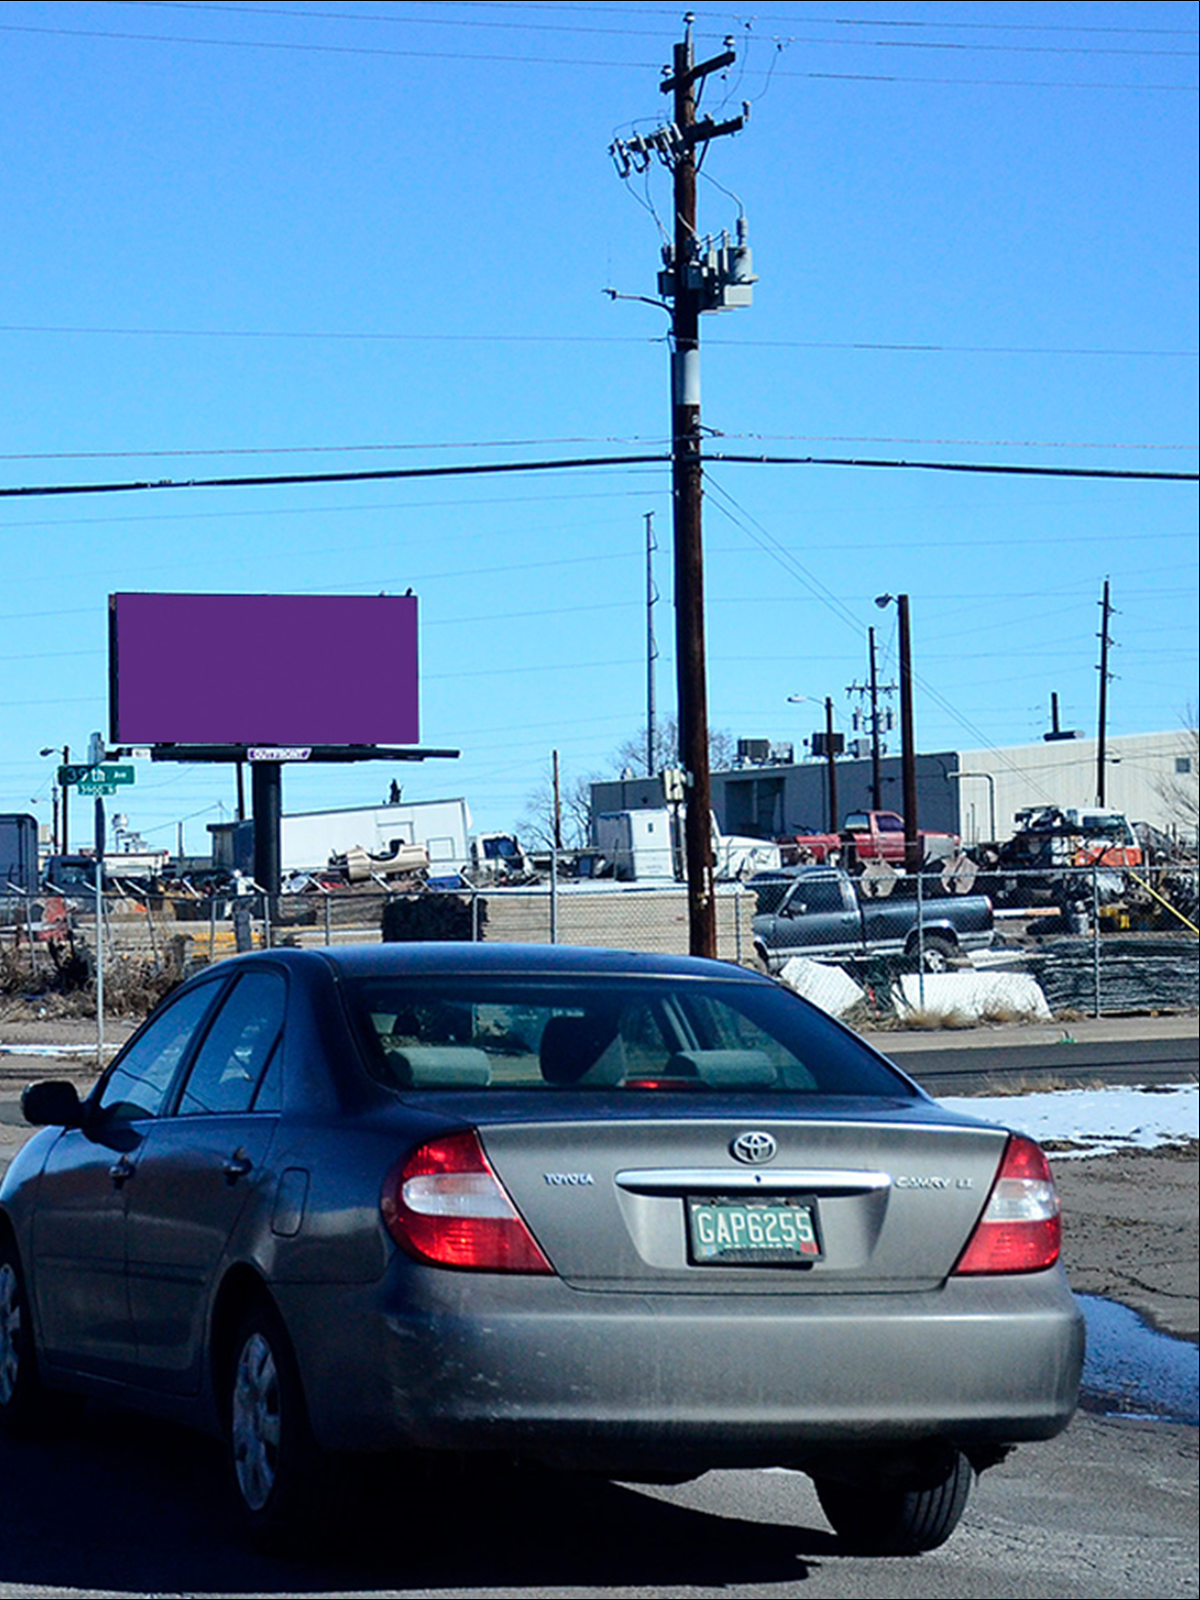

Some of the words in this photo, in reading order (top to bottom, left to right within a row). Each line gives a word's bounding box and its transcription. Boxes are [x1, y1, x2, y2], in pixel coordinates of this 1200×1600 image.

[65, 767, 105, 783] 39th
[543, 1173, 594, 1185] TOYOTA
[895, 1175, 950, 1188] CAMRY
[698, 1212, 814, 1243] GAP6255
